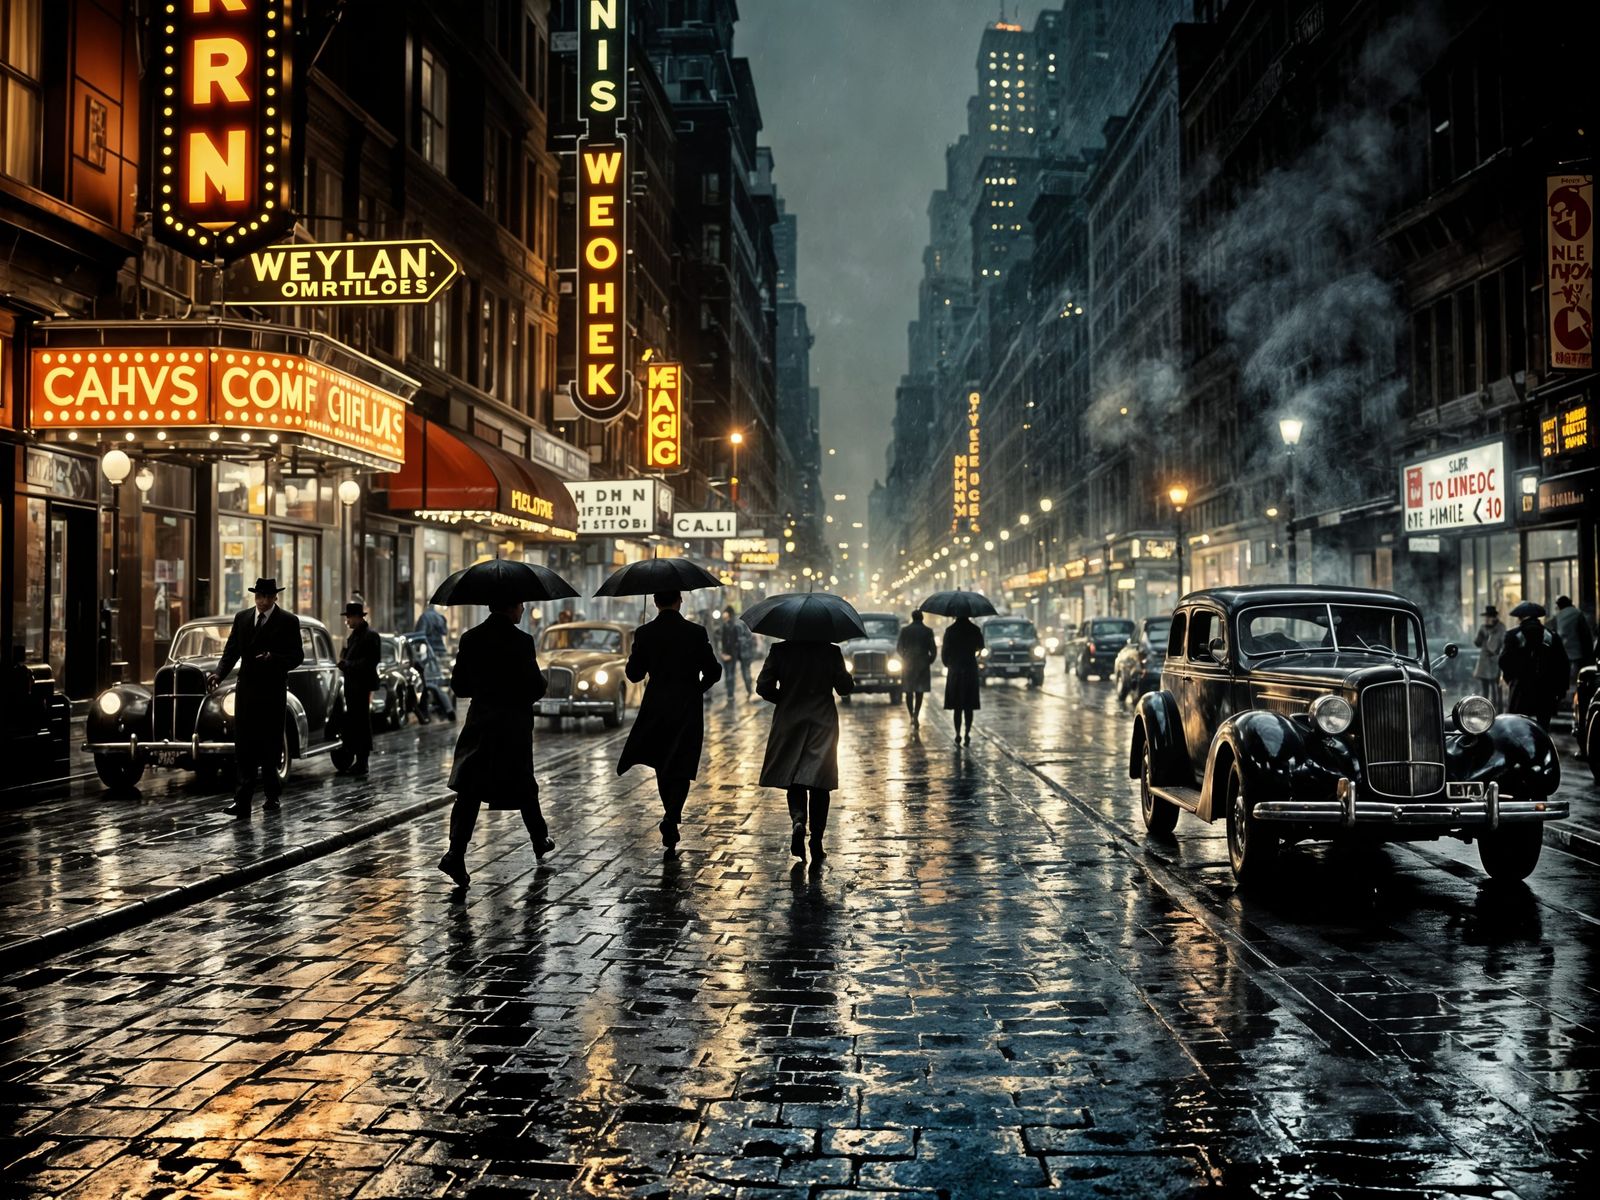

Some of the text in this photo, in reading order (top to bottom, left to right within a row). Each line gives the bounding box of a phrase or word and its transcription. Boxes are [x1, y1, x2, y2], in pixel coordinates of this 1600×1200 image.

[188, 0, 250, 204] RN
[281, 279, 428, 298] OMRTILOES
[583, 152, 622, 396] WEOHEK
[43, 365, 199, 407] CAHVS
